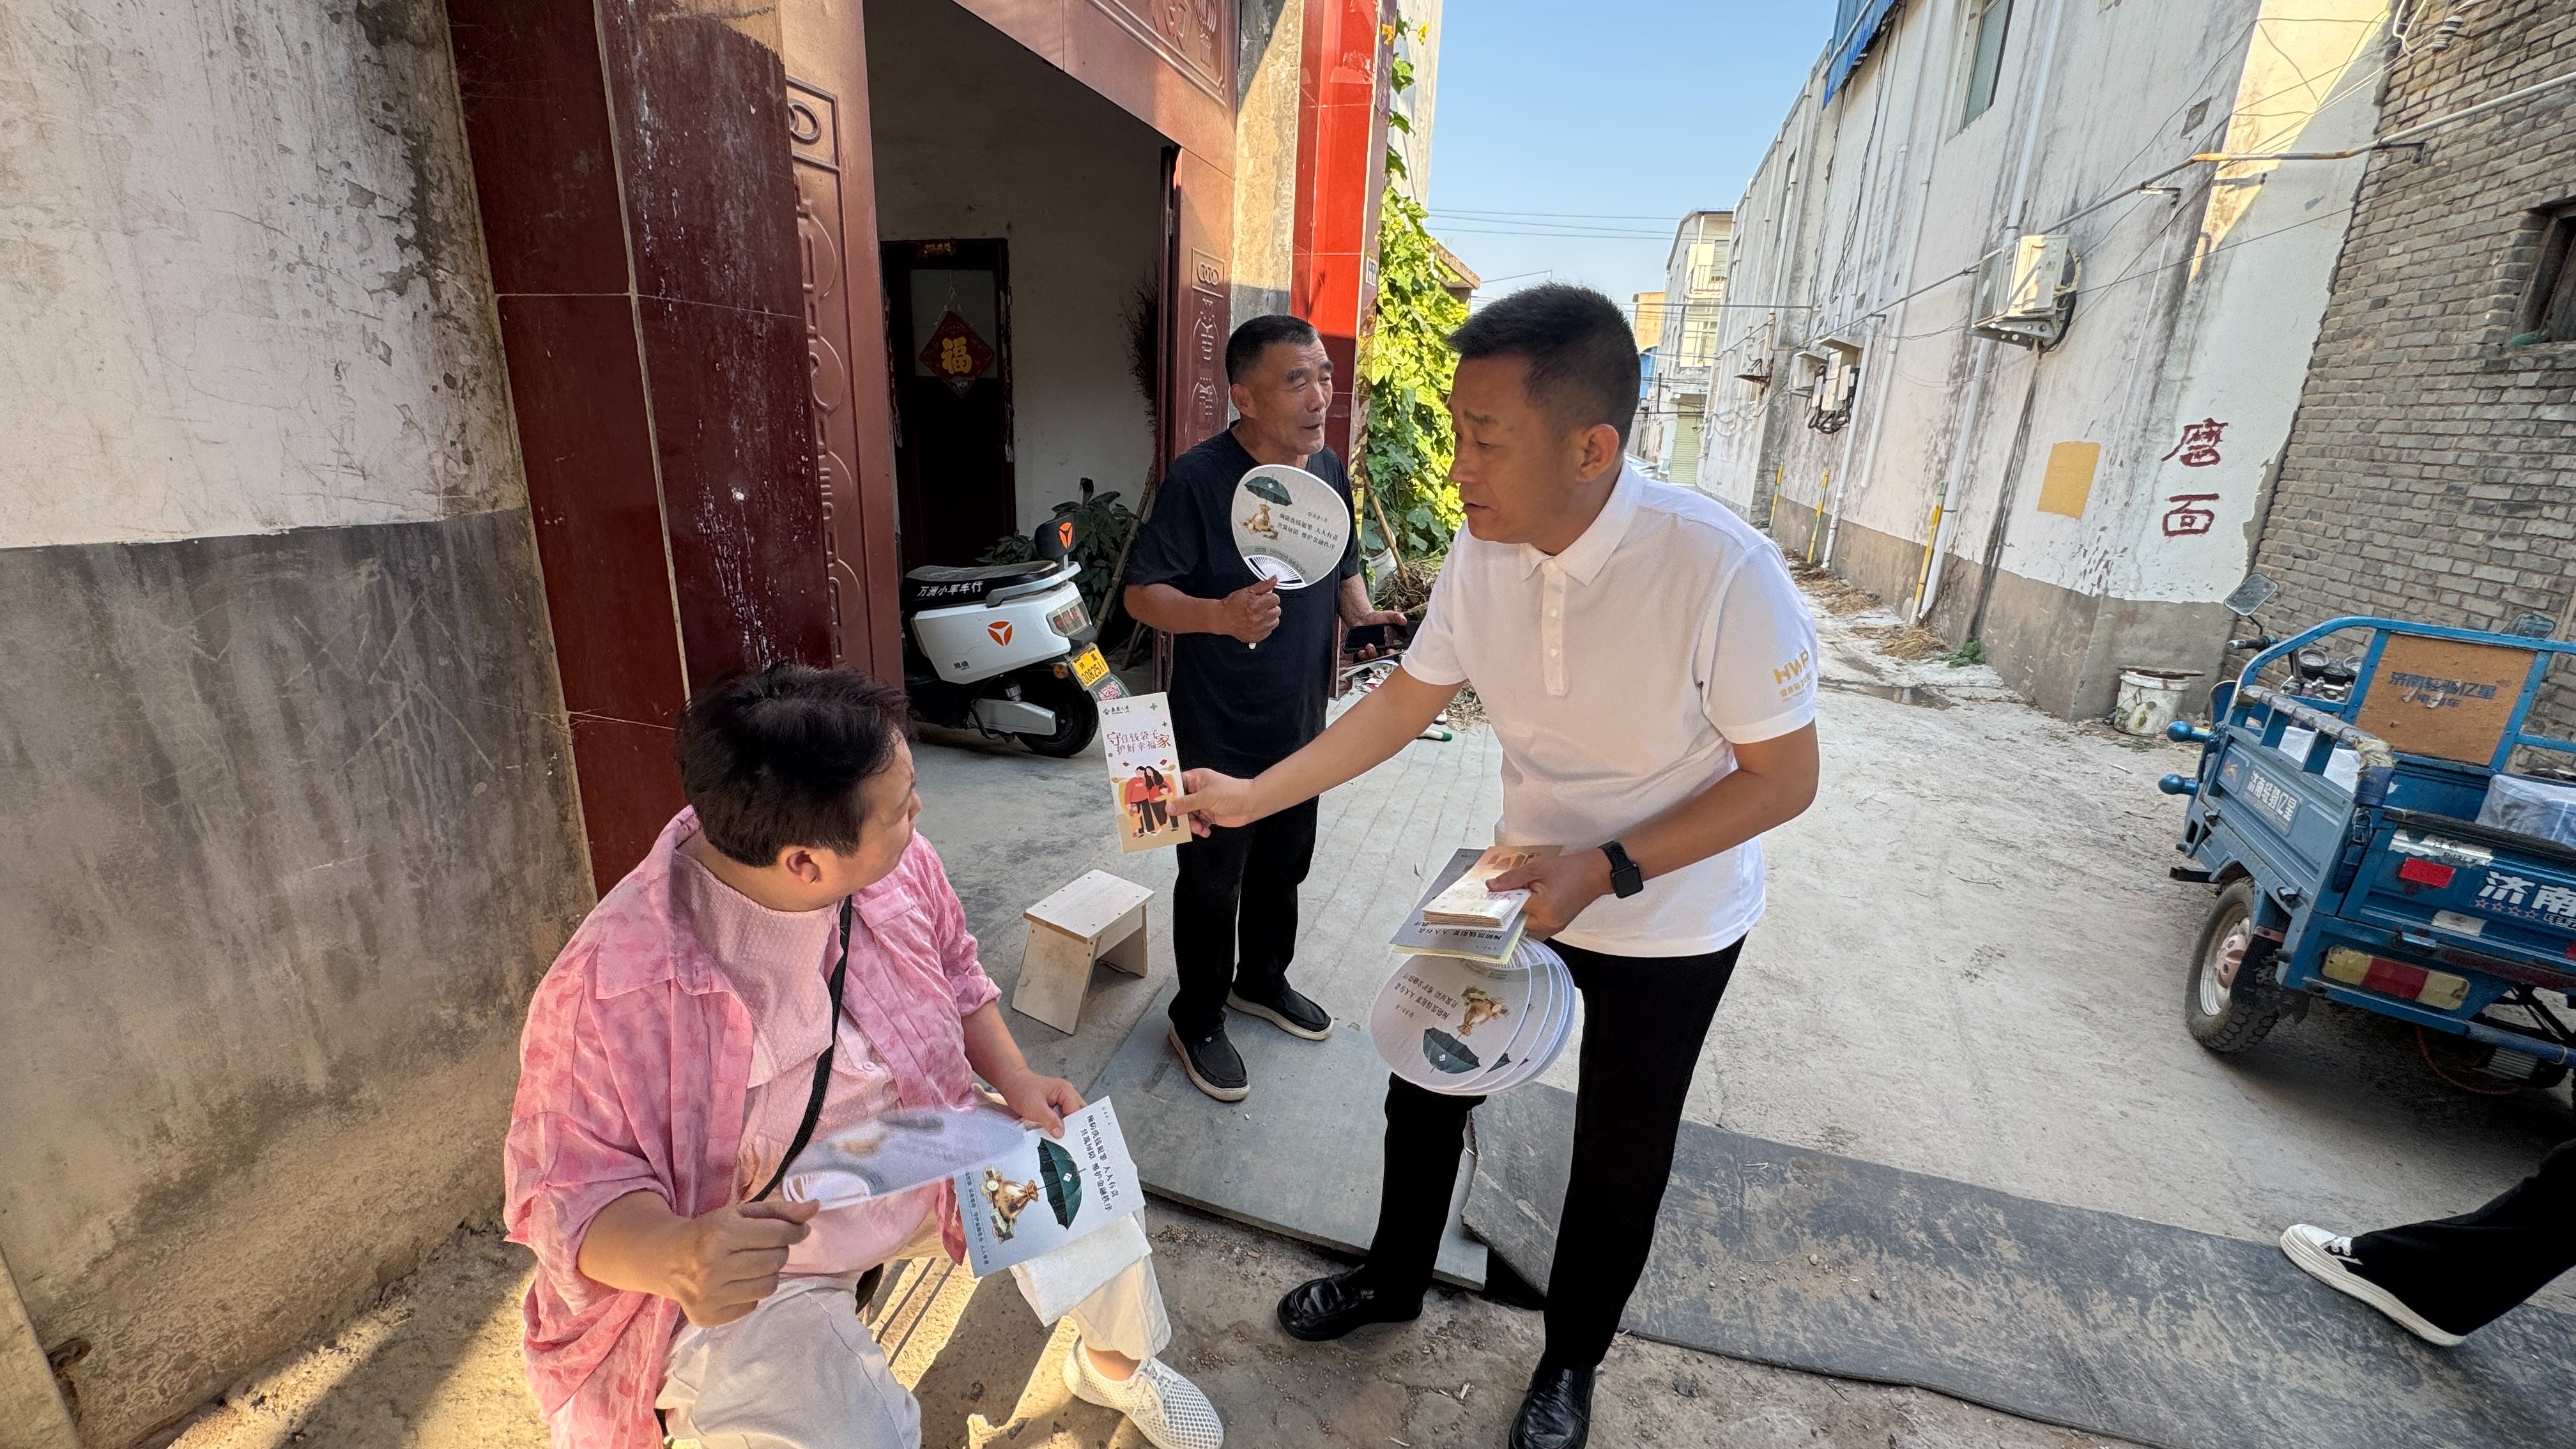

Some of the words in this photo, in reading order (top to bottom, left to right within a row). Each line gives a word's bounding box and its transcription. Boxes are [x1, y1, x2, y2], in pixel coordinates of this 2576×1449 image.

[941, 337, 972, 374] 福
[1081, 659, 1107, 684] 0082511
[1774, 650, 1809, 684] HWP
